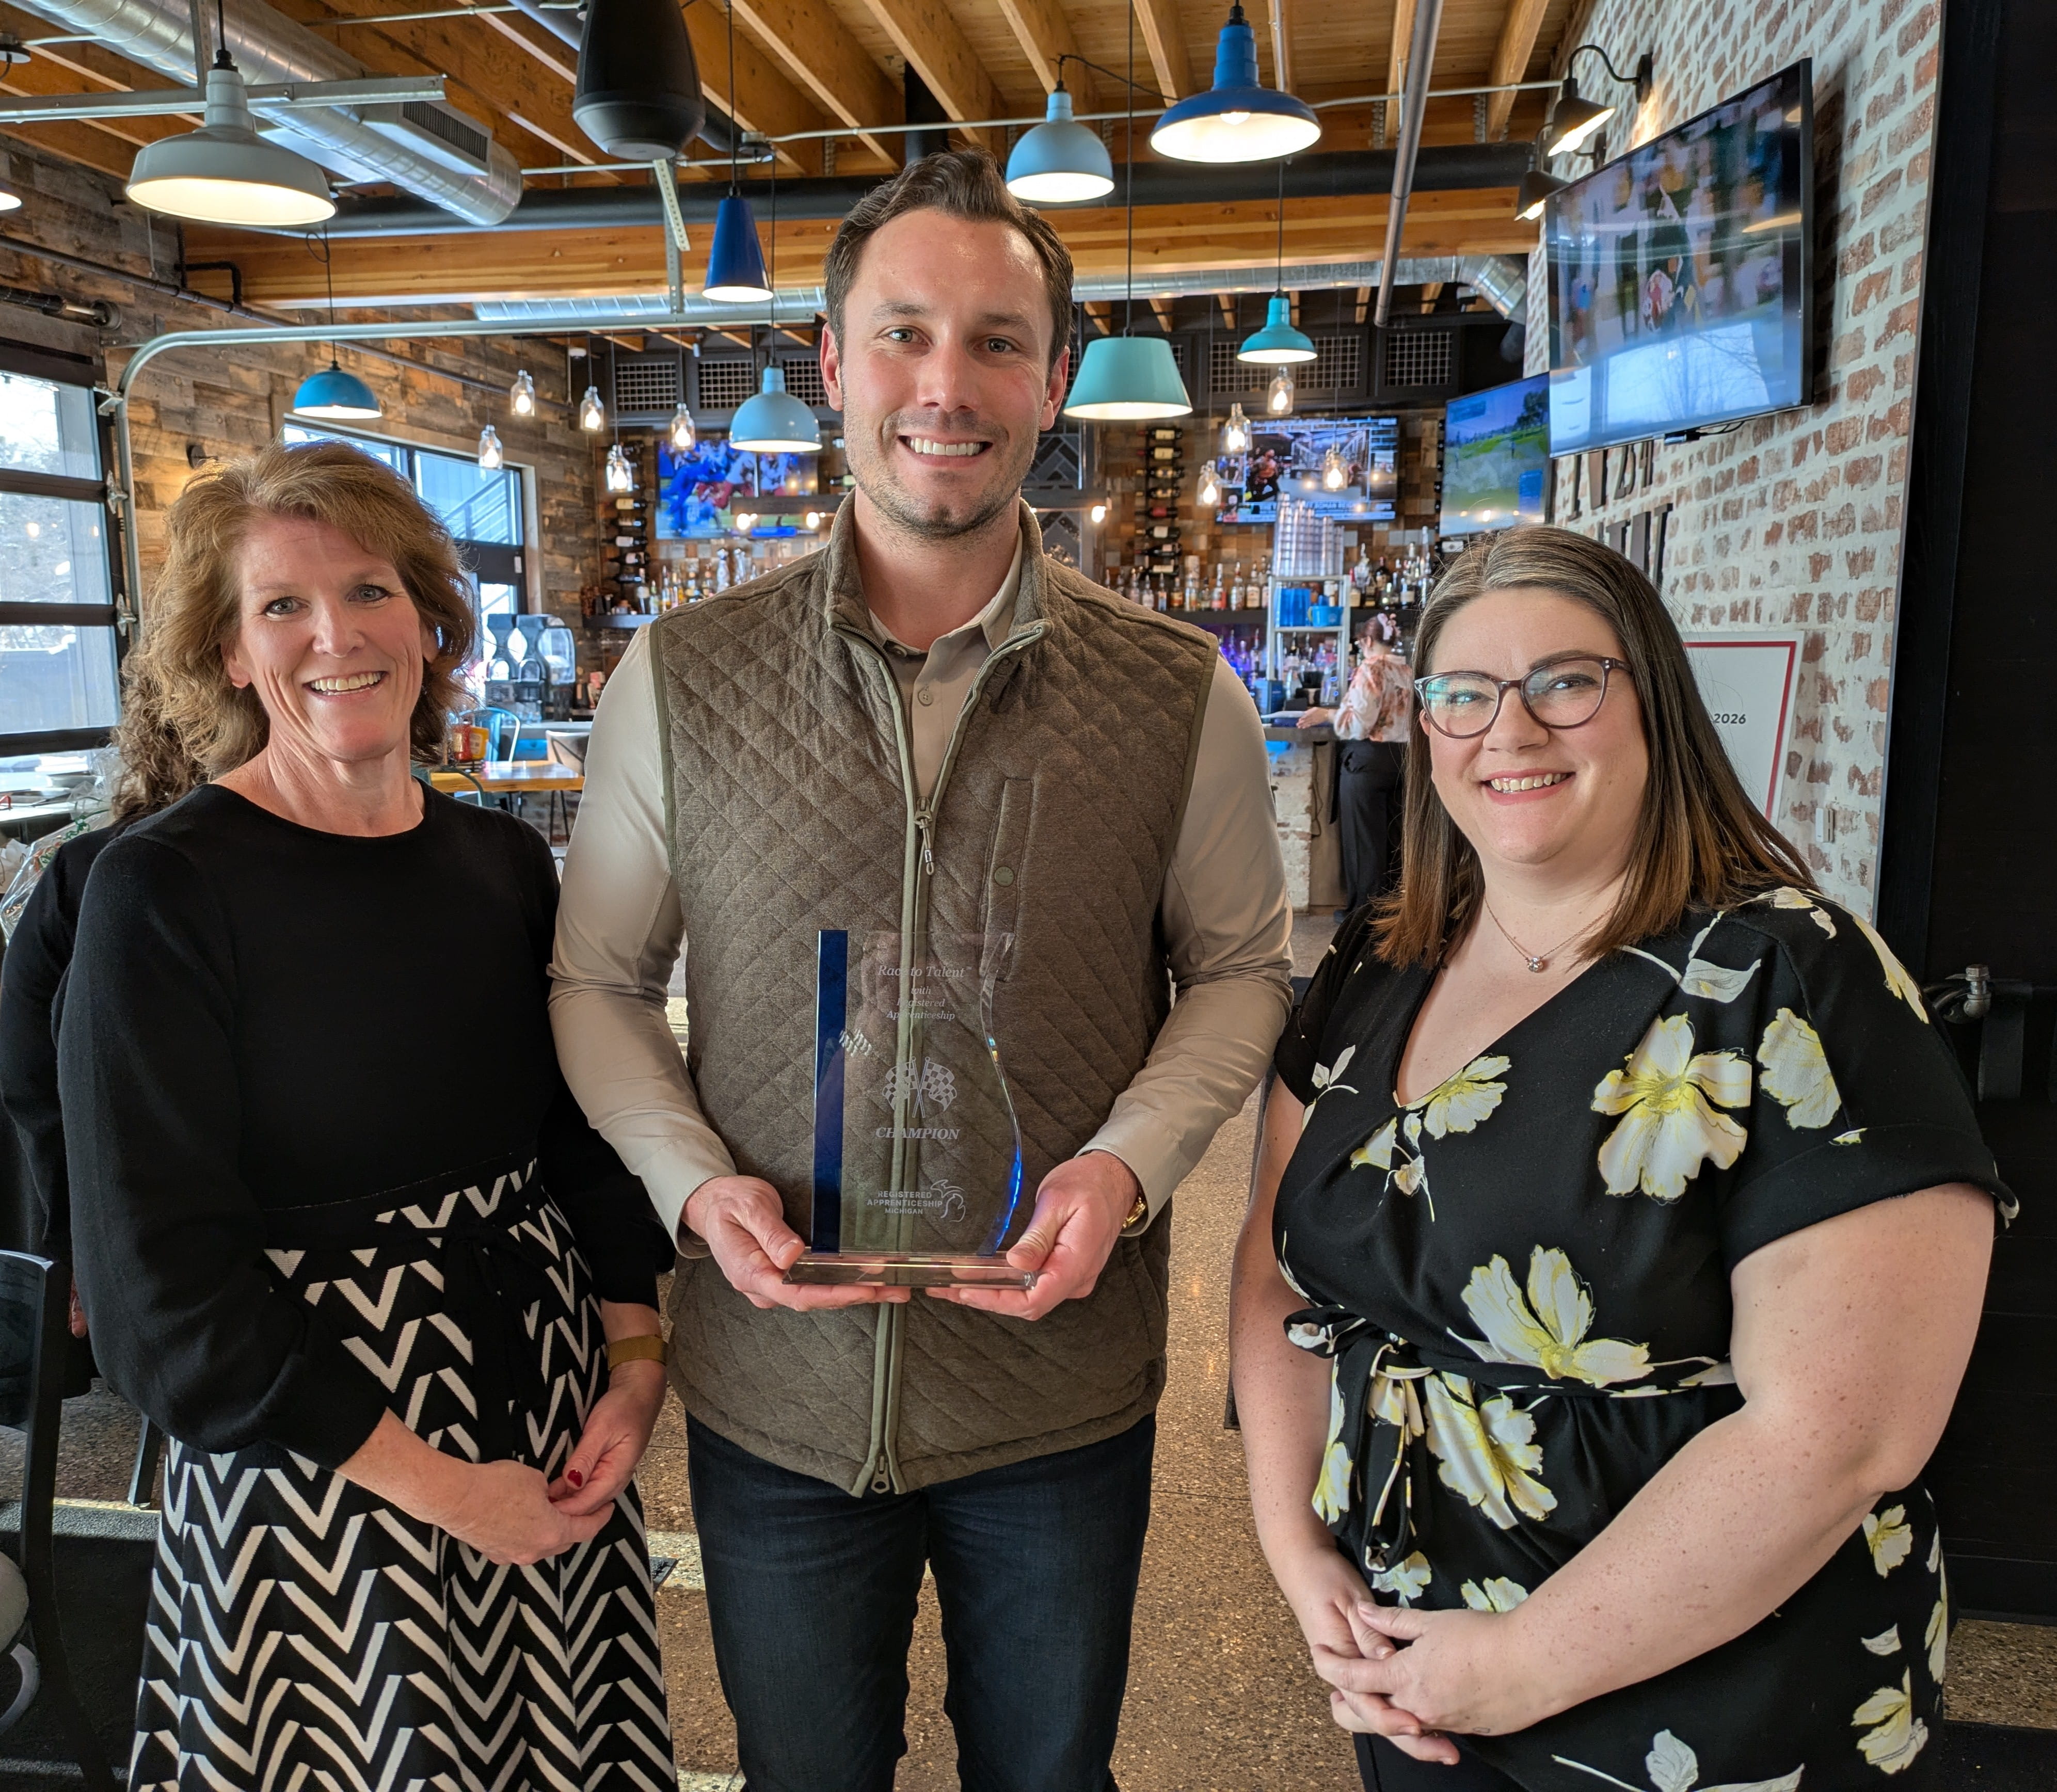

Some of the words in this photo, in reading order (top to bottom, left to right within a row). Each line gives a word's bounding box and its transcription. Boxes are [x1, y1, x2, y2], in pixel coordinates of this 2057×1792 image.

[1713, 713, 1746, 724] 2026
[878, 965, 907, 976] Rac
[911, 967, 922, 977] to
[911, 986, 931, 995] with
[897, 998, 945, 1009] gistered
[876, 1127, 961, 1139] CHAMPION
